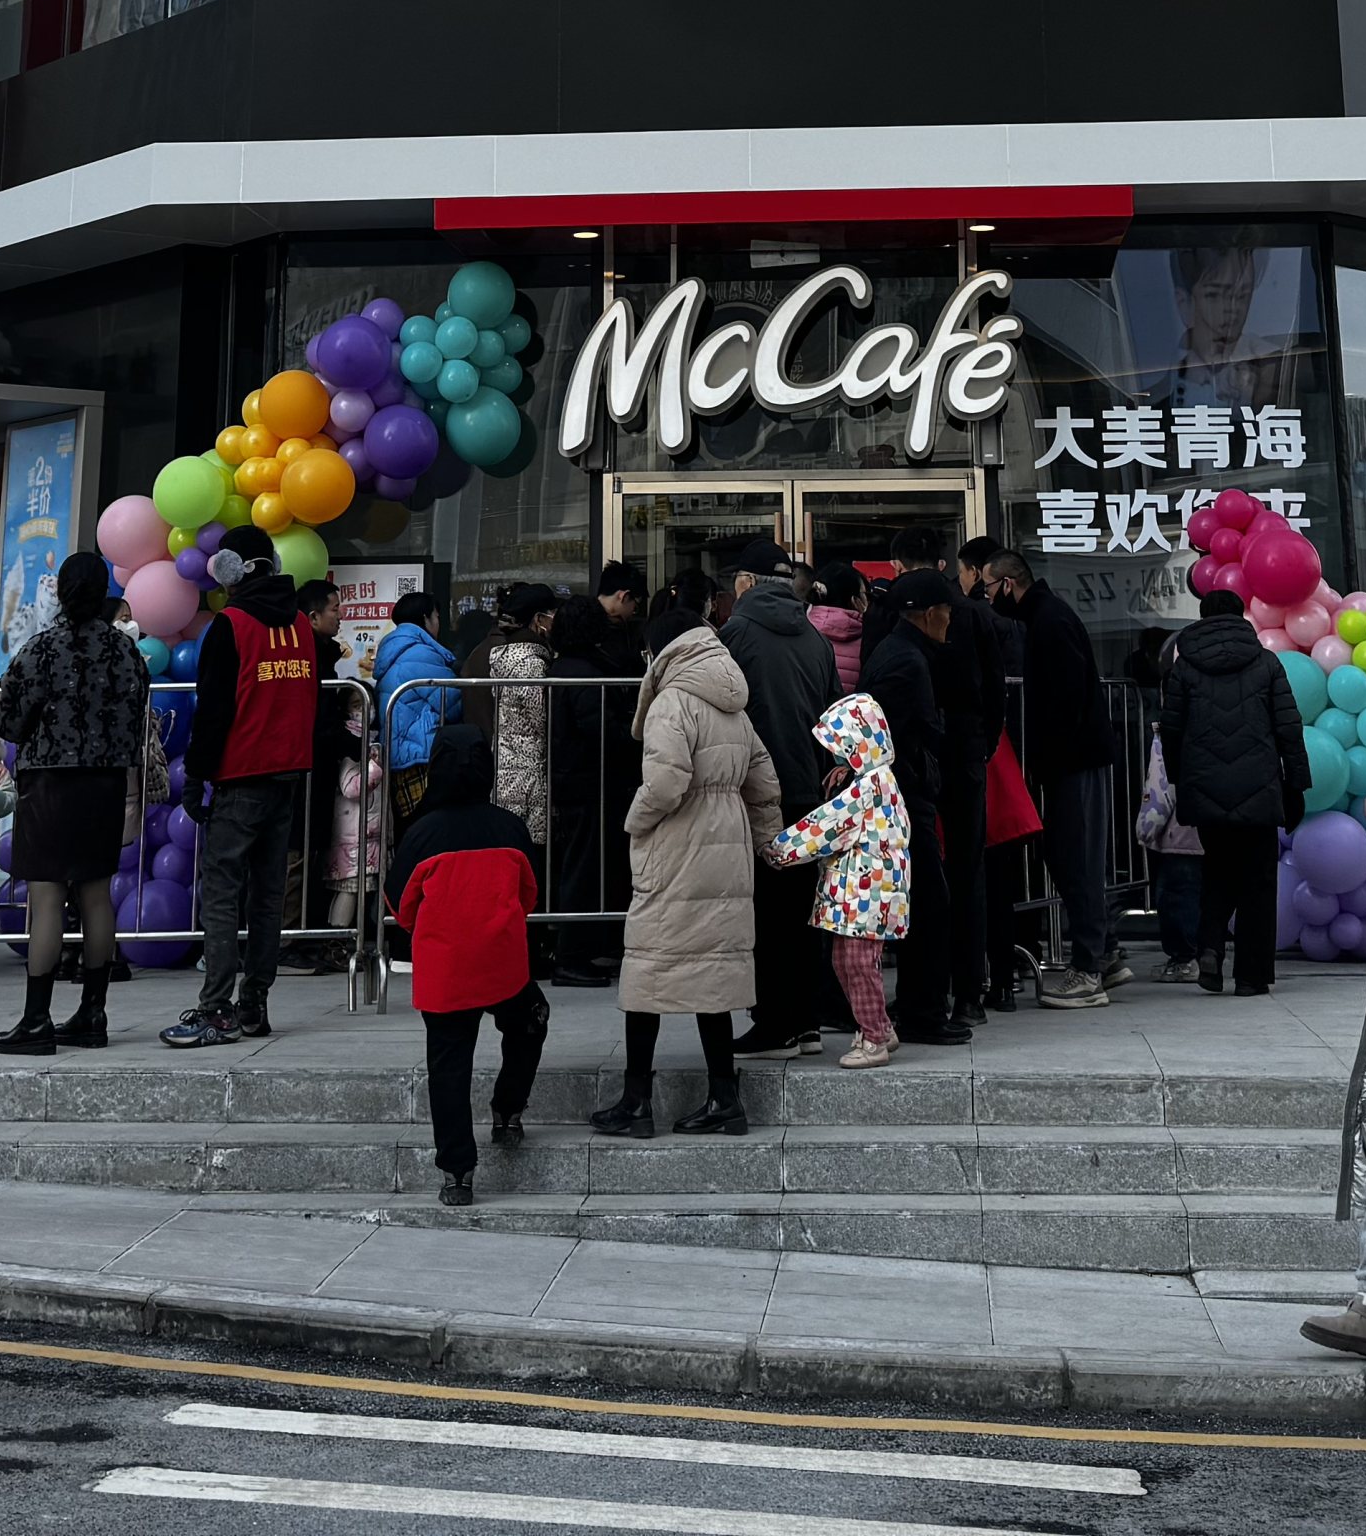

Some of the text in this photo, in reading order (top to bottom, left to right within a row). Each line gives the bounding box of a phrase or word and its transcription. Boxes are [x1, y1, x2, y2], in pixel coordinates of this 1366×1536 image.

[559, 264, 1024, 460] McCafé
[1034, 404, 1307, 469] 大美青海
[26, 486, 51, 518] 半价
[340, 581, 377, 602] 限时
[345, 606, 389, 618] 开业礼包
[257, 659, 311, 681] 喜欢您来
